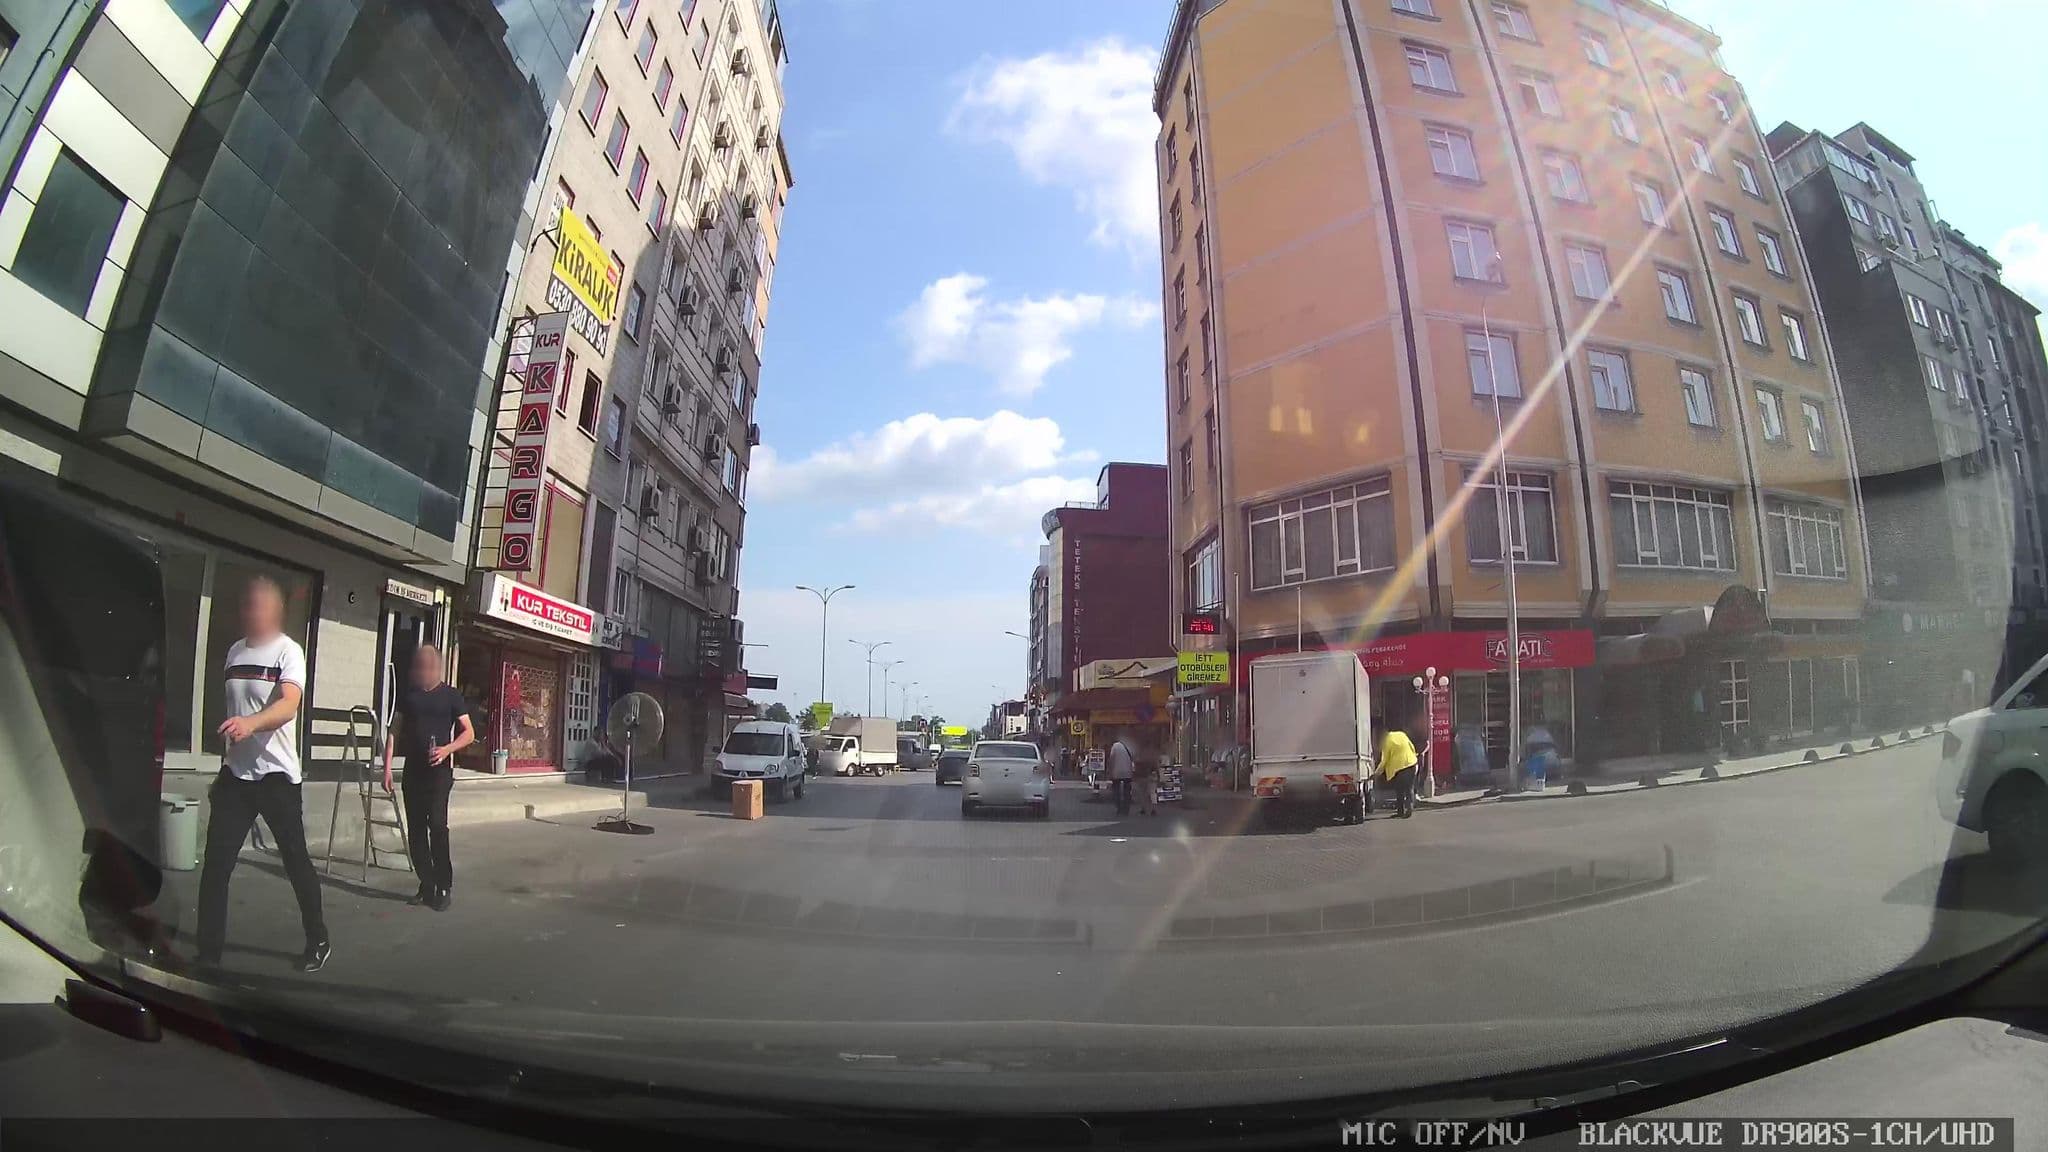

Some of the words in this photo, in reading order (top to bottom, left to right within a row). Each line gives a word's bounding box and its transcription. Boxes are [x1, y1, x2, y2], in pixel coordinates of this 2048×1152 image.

[550, 279, 571, 312] 0530
[535, 332, 560, 349] KUR
[504, 364, 557, 567] KARGO
[516, 593, 543, 616] KUR
[1486, 639, 1553, 659] FAATIC
[1180, 662, 1227, 672] OTOBÜSLERİ
[1187, 672, 1221, 682] GİREMEZ
